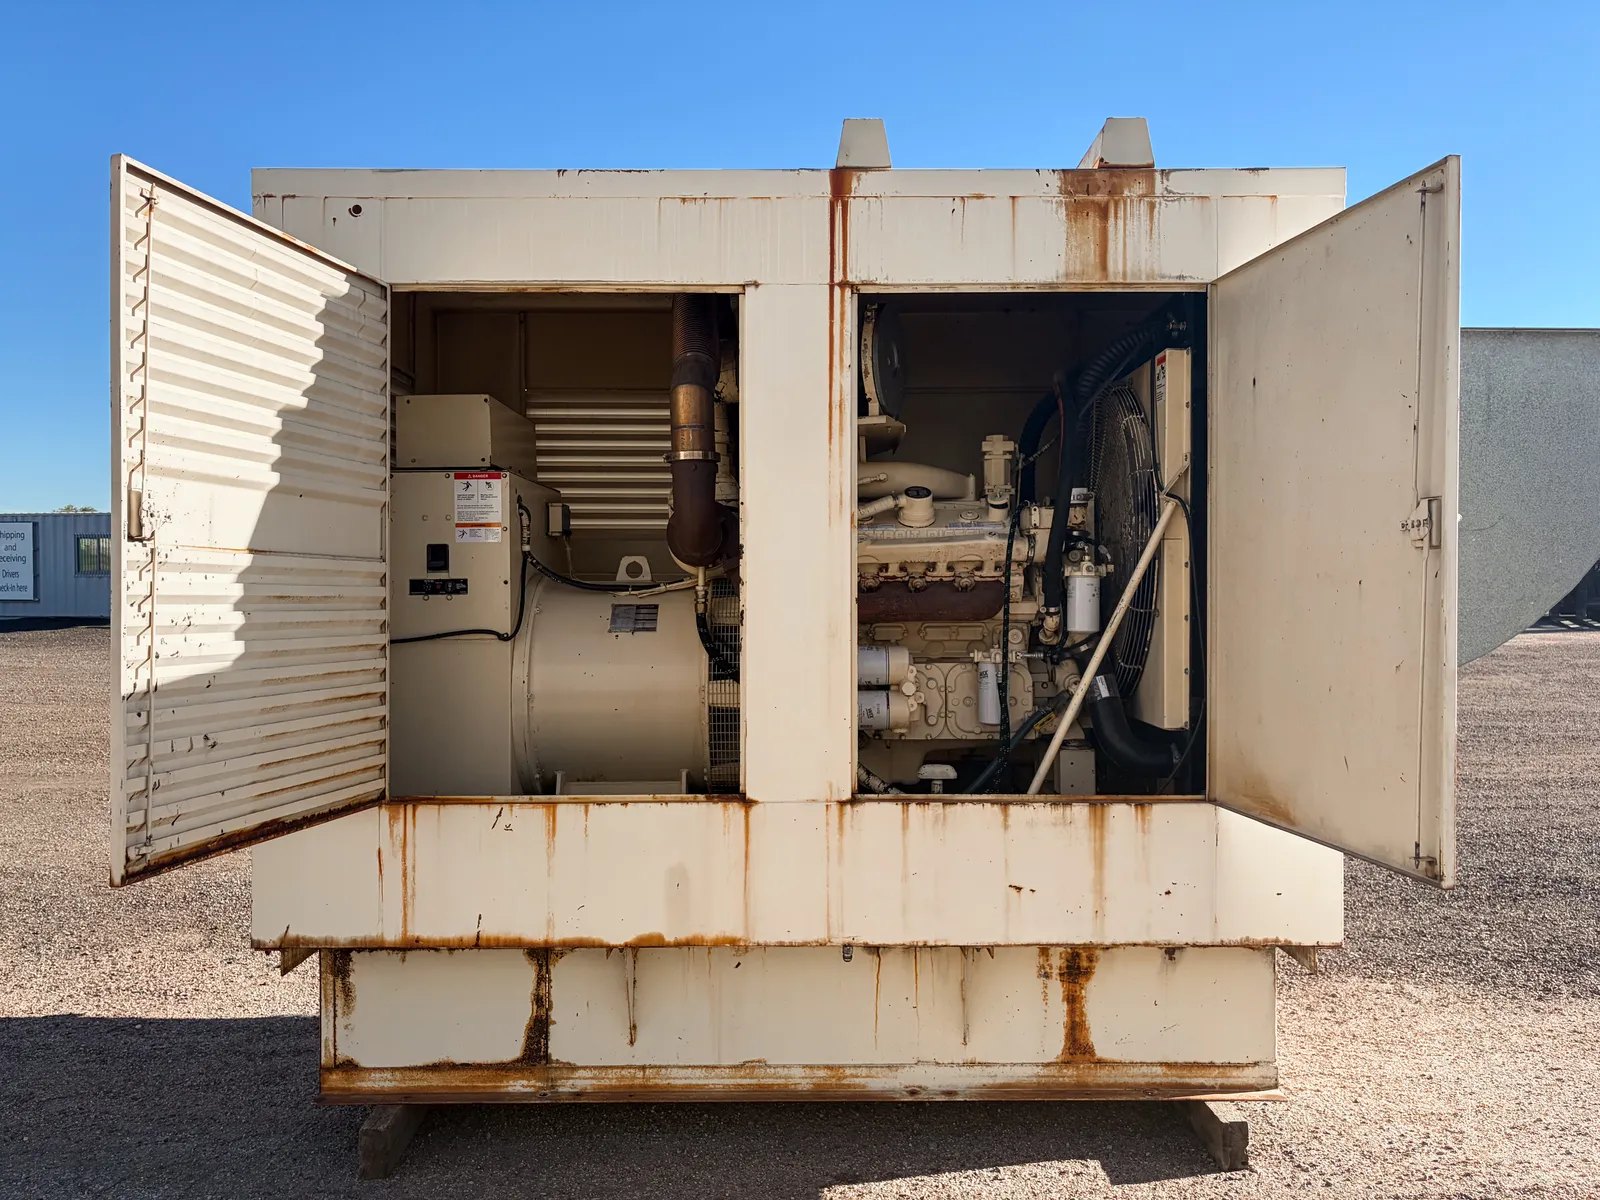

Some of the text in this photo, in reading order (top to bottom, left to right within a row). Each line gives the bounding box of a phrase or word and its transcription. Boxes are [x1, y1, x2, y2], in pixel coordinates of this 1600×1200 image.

[0, 530, 25, 541] hipping
[4, 543, 17, 552] and
[0, 554, 27, 565] eceiving
[2, 569, 20, 579] Drivers
[0, 583, 28, 592] eck-In here
